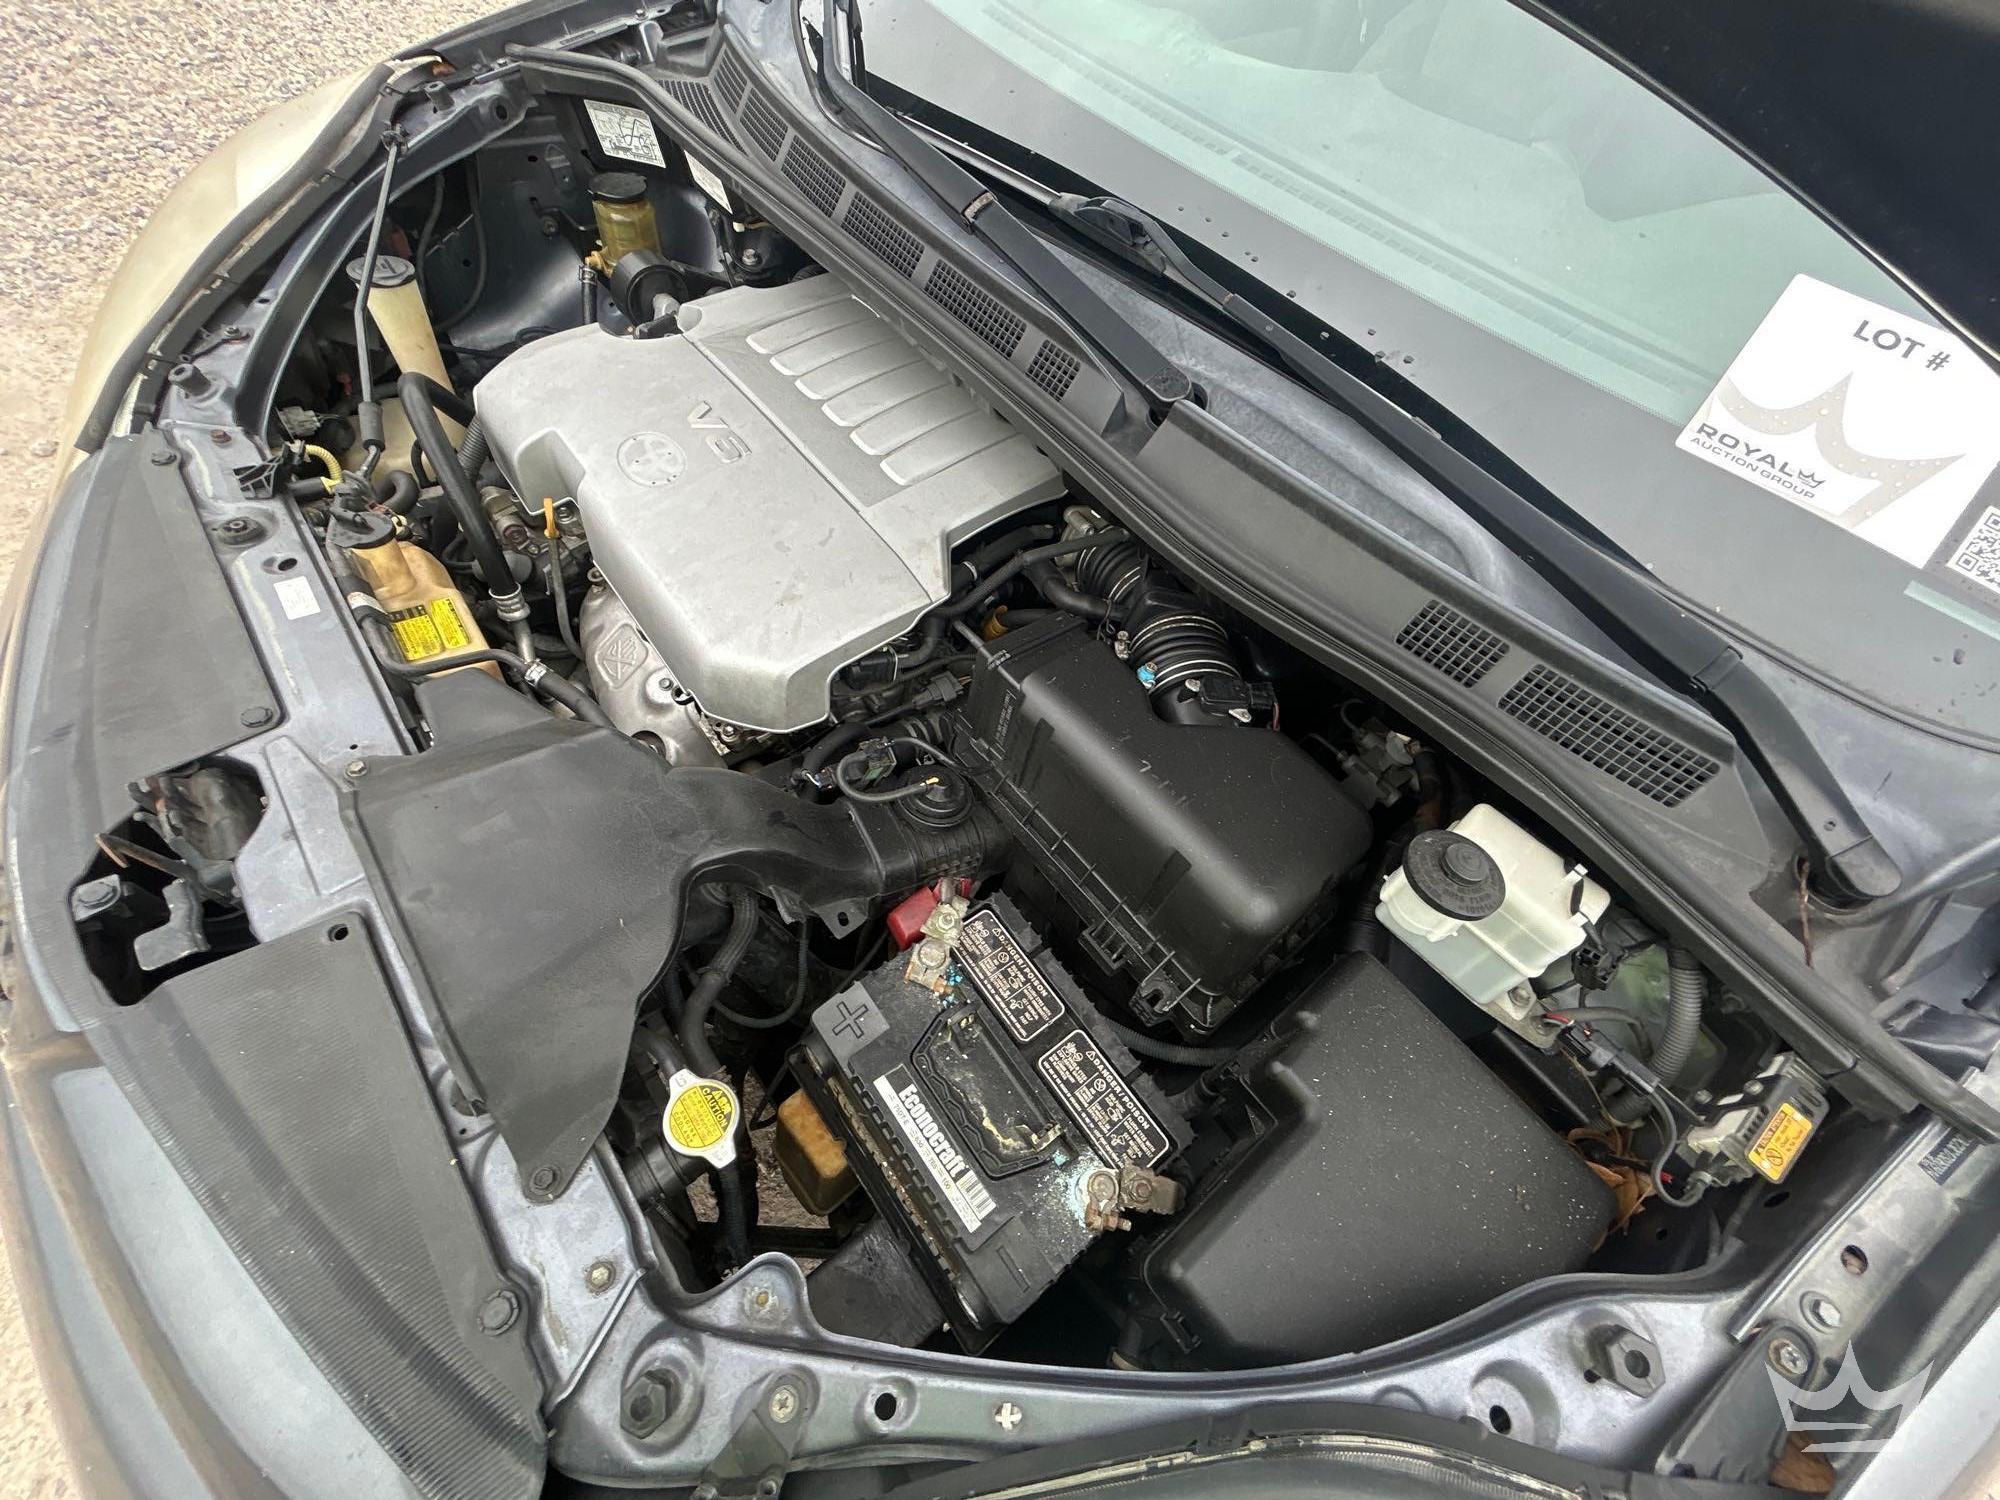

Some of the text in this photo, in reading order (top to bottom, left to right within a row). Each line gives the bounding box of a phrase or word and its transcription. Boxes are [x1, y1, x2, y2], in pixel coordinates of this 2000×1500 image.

[1853, 320, 1951, 371] LOT #
[1690, 437, 1815, 499] AUCTION GROUP
[1696, 423, 1793, 477] ROYAL
[999, 935, 1048, 997] DANGER/POISON
[702, 1088, 728, 1127] CAUTION
[1091, 1057, 1150, 1129] DANGER/POISON
[898, 1084, 969, 1177] Econocraft
